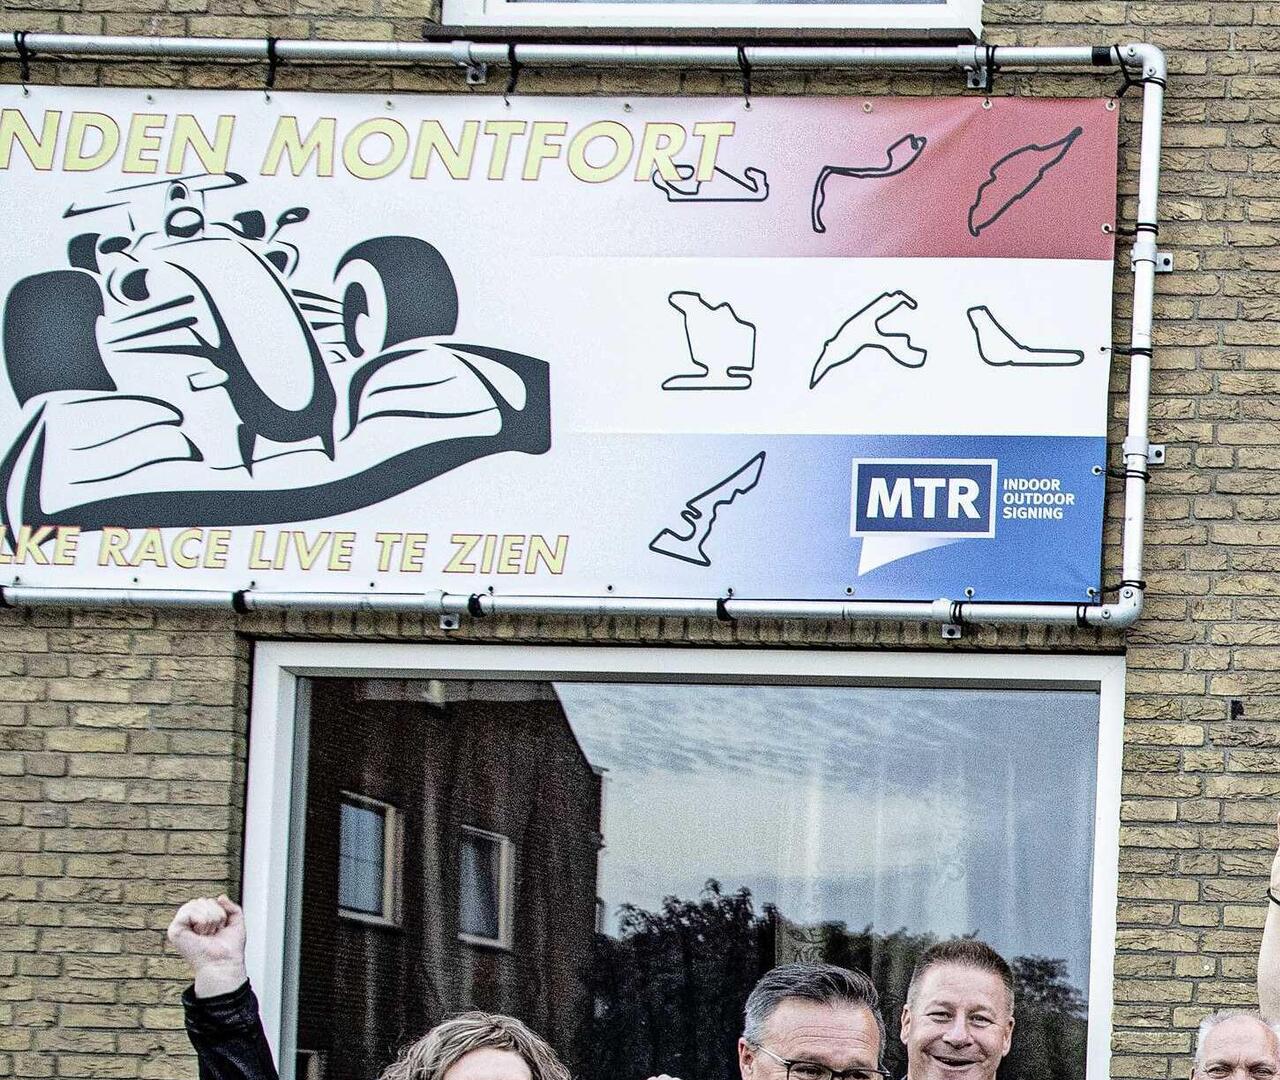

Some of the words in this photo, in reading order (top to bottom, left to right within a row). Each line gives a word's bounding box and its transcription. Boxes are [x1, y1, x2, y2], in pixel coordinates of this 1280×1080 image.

[260, 115, 735, 183] MONTFORT
[867, 477, 981, 519] MTR
[1003, 478, 1061, 491] INDOOR
[1003, 493, 1075, 505] OUTDOOR
[1003, 507, 1063, 519] SIGNING
[97, 527, 230, 569] RACE
[248, 530, 355, 570] LIVE
[375, 533, 429, 572] TE
[443, 534, 570, 575] ZIEN
